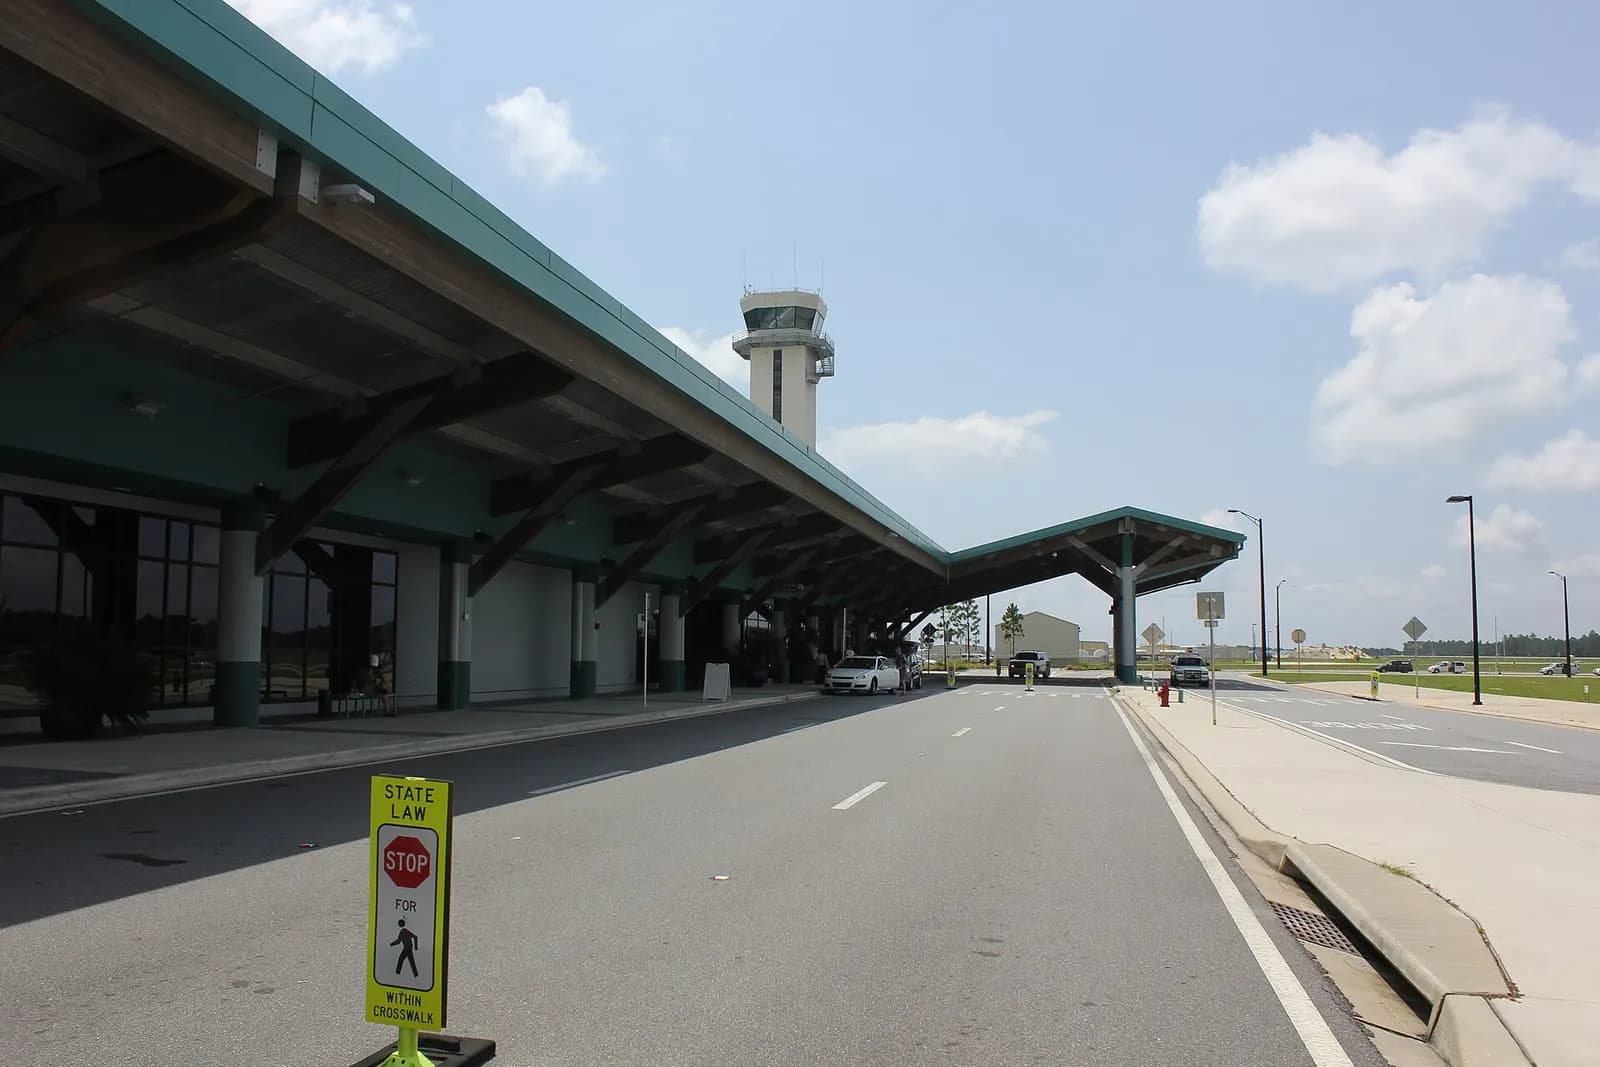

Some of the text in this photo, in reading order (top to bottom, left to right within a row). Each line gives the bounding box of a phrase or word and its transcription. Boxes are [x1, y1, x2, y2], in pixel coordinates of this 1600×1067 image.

[384, 784, 435, 803] STATE
[391, 804, 426, 821] LAW
[385, 851, 428, 873] STOP
[395, 899, 417, 912] FOR
[386, 992, 422, 1007] WITHIN
[373, 1005, 434, 1025] CROSSWALK
